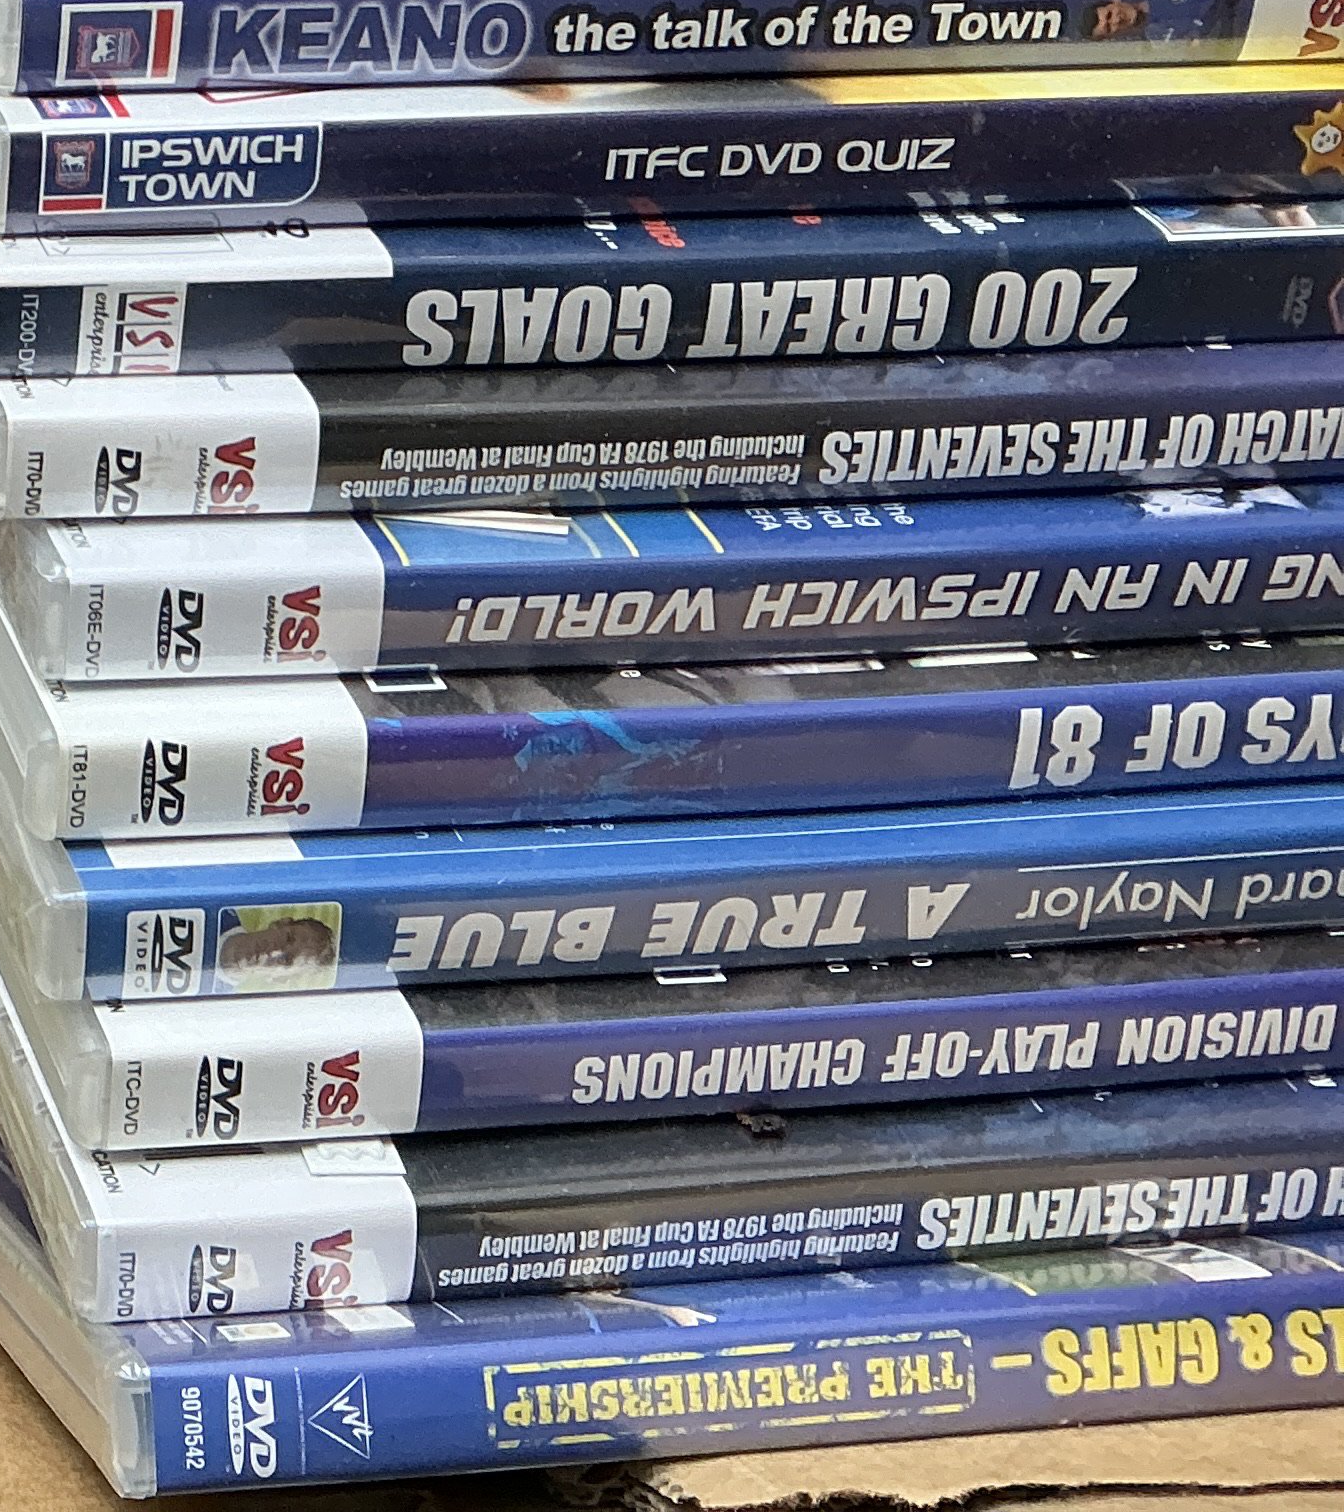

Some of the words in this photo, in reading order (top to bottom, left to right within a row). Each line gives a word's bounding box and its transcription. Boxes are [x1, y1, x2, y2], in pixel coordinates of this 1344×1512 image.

[213, 0, 530, 77] KEANO
[553, 7, 636, 54] the
[653, 7, 750, 51] talk
[763, 4, 820, 47] of
[831, 2, 915, 47] the
[930, 0, 1063, 43] Town
[121, 133, 304, 170] IPSWICH
[605, 146, 710, 182] ITFC
[719, 142, 822, 178] DVD
[836, 137, 956, 174] QUIZ
[118, 170, 256, 203] TOWN
[402, 282, 673, 367] GOALS
[688, 272, 952, 359] GREAT
[969, 266, 1138, 349] 200
[380, 446, 477, 472] Wembley
[481, 447, 502, 469] at
[556, 441, 596, 466] Cup
[673, 438, 707, 461] the
[709, 434, 805, 460] including
[820, 423, 1056, 486] SEVENTIES
[1065, 419, 1148, 472] THE
[1149, 416, 1215, 469] OF
[340, 477, 410, 499] games
[412, 474, 467, 499] great
[471, 473, 530, 496] dozen
[533, 473, 546, 492] a
[549, 471, 598, 494] from
[599, 466, 702, 491] highlights
[744, 571, 1042, 628] IPSWICH
[1173, 557, 1250, 607] IN
[446, 587, 718, 646] WORLD!
[1010, 704, 1103, 789] 81
[1125, 701, 1226, 774] OF
[640, 888, 870, 958] TRUE
[1016, 870, 1212, 930] Naylor
[388, 907, 617, 974] BLUE
[882, 1021, 1100, 1083] PLAY-OFF
[1116, 1004, 1338, 1067] DIVISION
[572, 1038, 866, 1106] CHAMPIONS
[916, 1180, 1161, 1250] SEVENTIES
[1163, 1174, 1249, 1229] THE
[1255, 1168, 1318, 1222] OF
[479, 1231, 576, 1258] Wembley
[579, 1229, 600, 1250] at
[603, 1225, 652, 1250] Final
[772, 1211, 805, 1234] the
[803, 1231, 900, 1256] Featuring
[438, 1262, 509, 1287] games
[510, 1257, 566, 1280] great
[569, 1253, 629, 1277] dozen
[633, 1253, 645, 1271] a
[698, 1238, 802, 1266] highlights
[1039, 1314, 1220, 1399] GAFFS
[504, 1361, 850, 1427] PREMIERSHIP
[181, 1386, 206, 1470] 9070542
